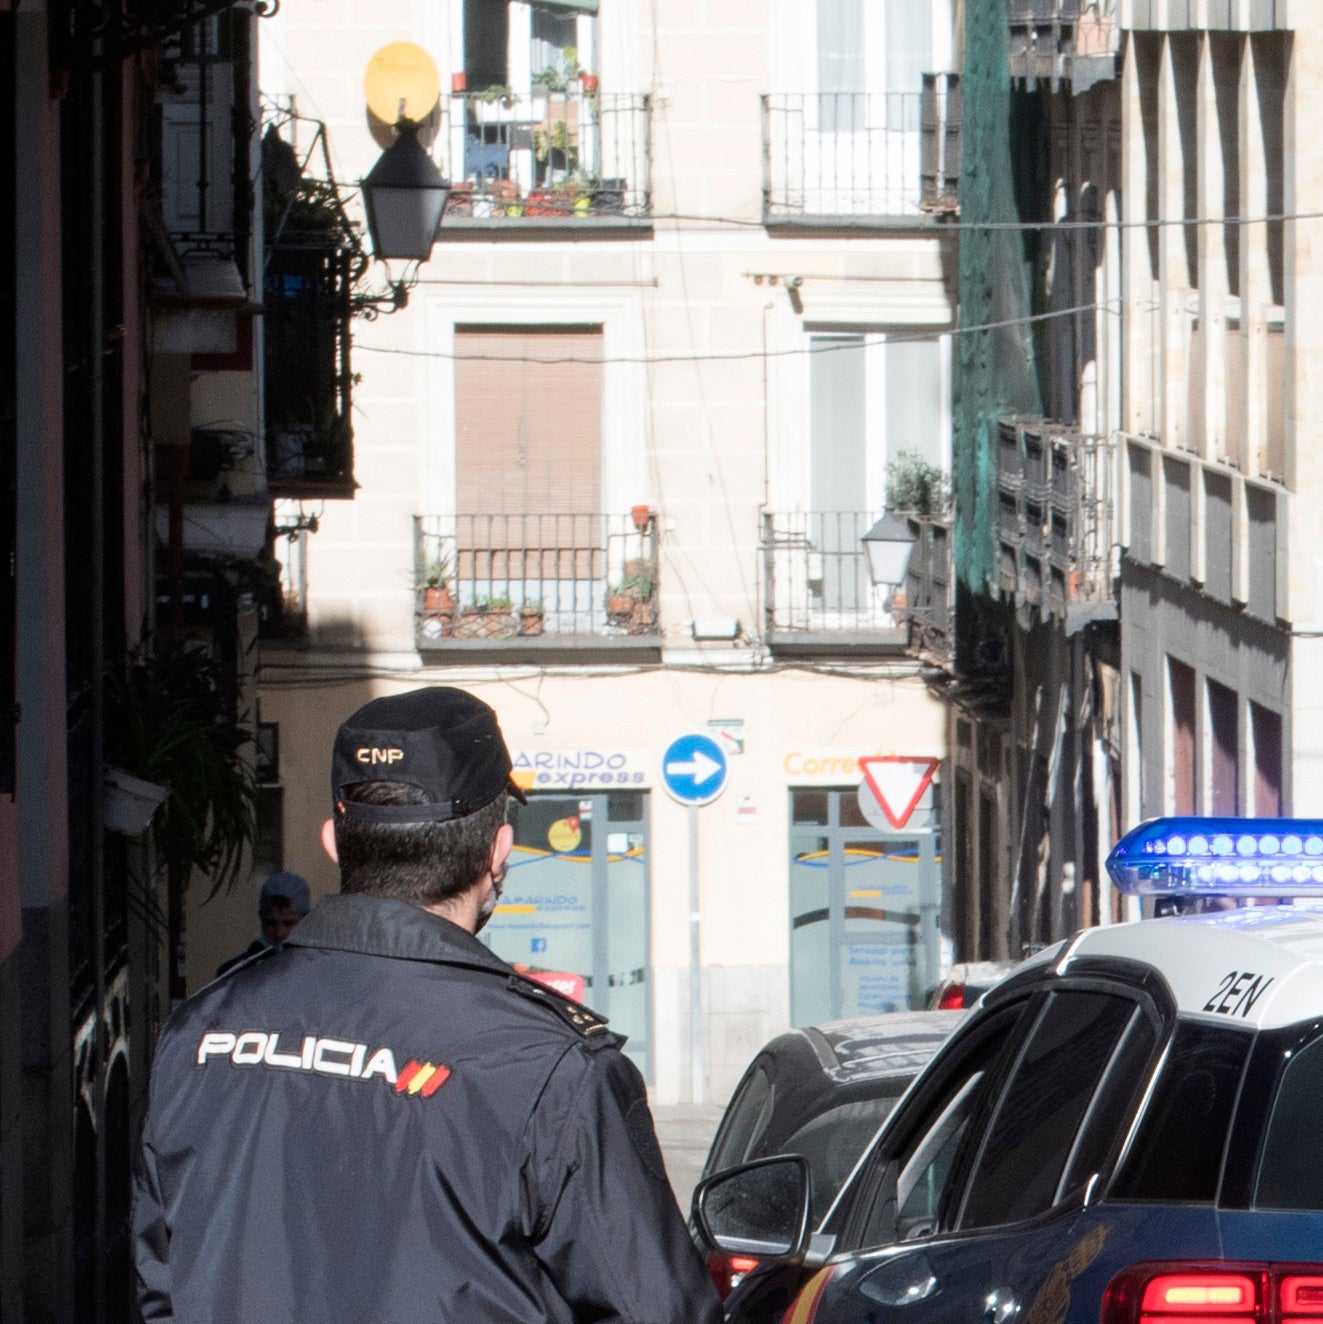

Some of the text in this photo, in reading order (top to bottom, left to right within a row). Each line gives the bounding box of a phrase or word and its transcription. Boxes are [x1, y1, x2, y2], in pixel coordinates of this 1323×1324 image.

[356, 747, 404, 765] CNP
[536, 771, 645, 789] express
[1202, 971, 1274, 1018] 2EN
[197, 1032, 398, 1084] POLICIA
